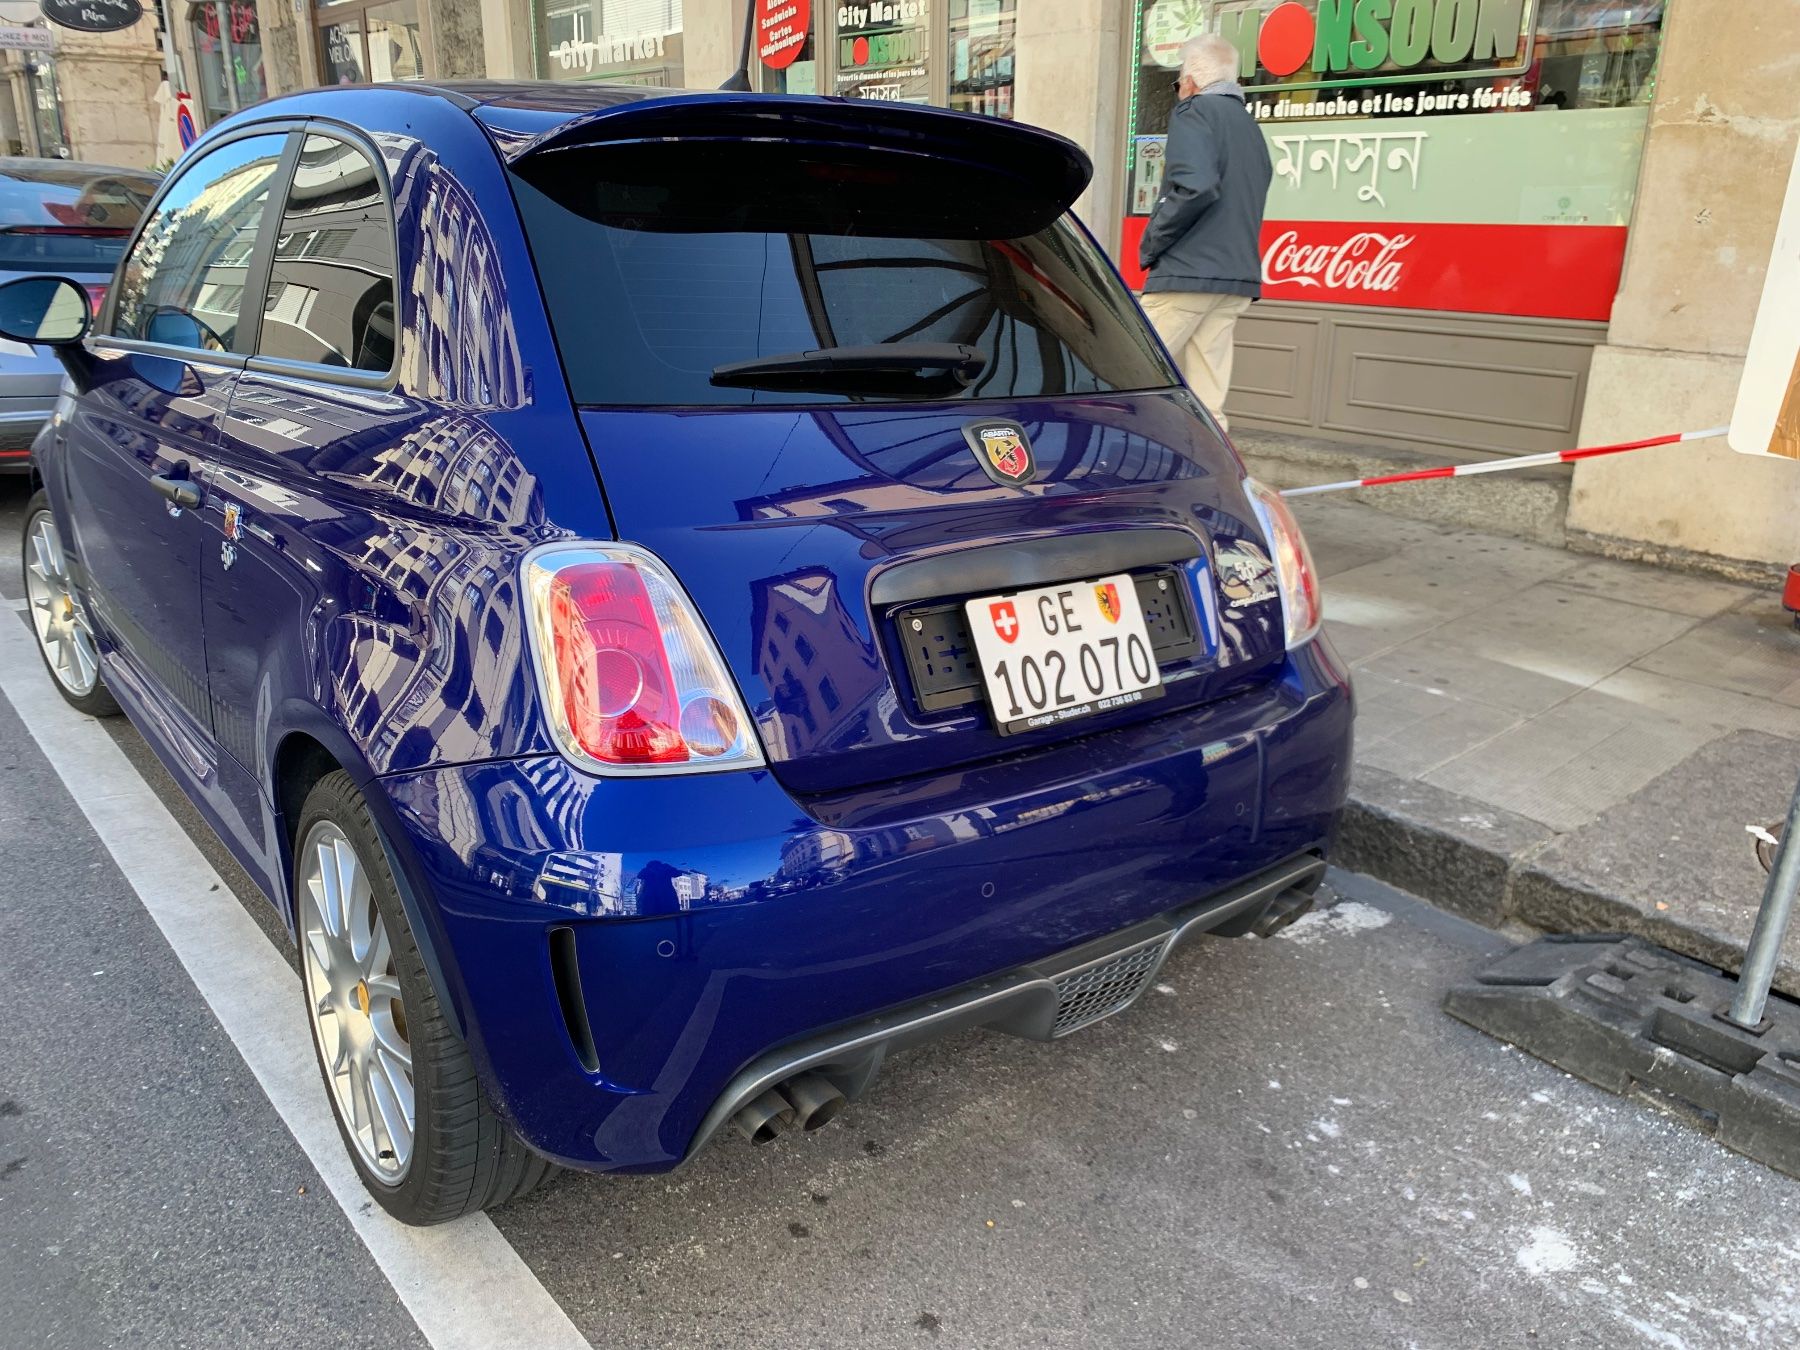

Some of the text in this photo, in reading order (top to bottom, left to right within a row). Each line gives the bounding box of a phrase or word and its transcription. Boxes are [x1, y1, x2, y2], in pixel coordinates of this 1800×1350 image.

[767, 0, 788, 10] Alco
[838, 0, 926, 28] City Market
[769, 25, 792, 42] Cartes
[559, 32, 664, 72] City Market
[1255, 100, 1270, 118] le
[1274, 96, 1359, 117] dimanche
[1361, 98, 1382, 114] et
[1384, 92, 1414, 113] les
[1416, 90, 1469, 116] jours
[1472, 85, 1532, 109] fériés
[1261, 230, 1416, 292] Coca-Cola
[983, 429, 1015, 438] ABARTH
[1037, 590, 1082, 636] GE
[994, 633, 1152, 717] 102 070
[1028, 714, 1054, 727] Garage
